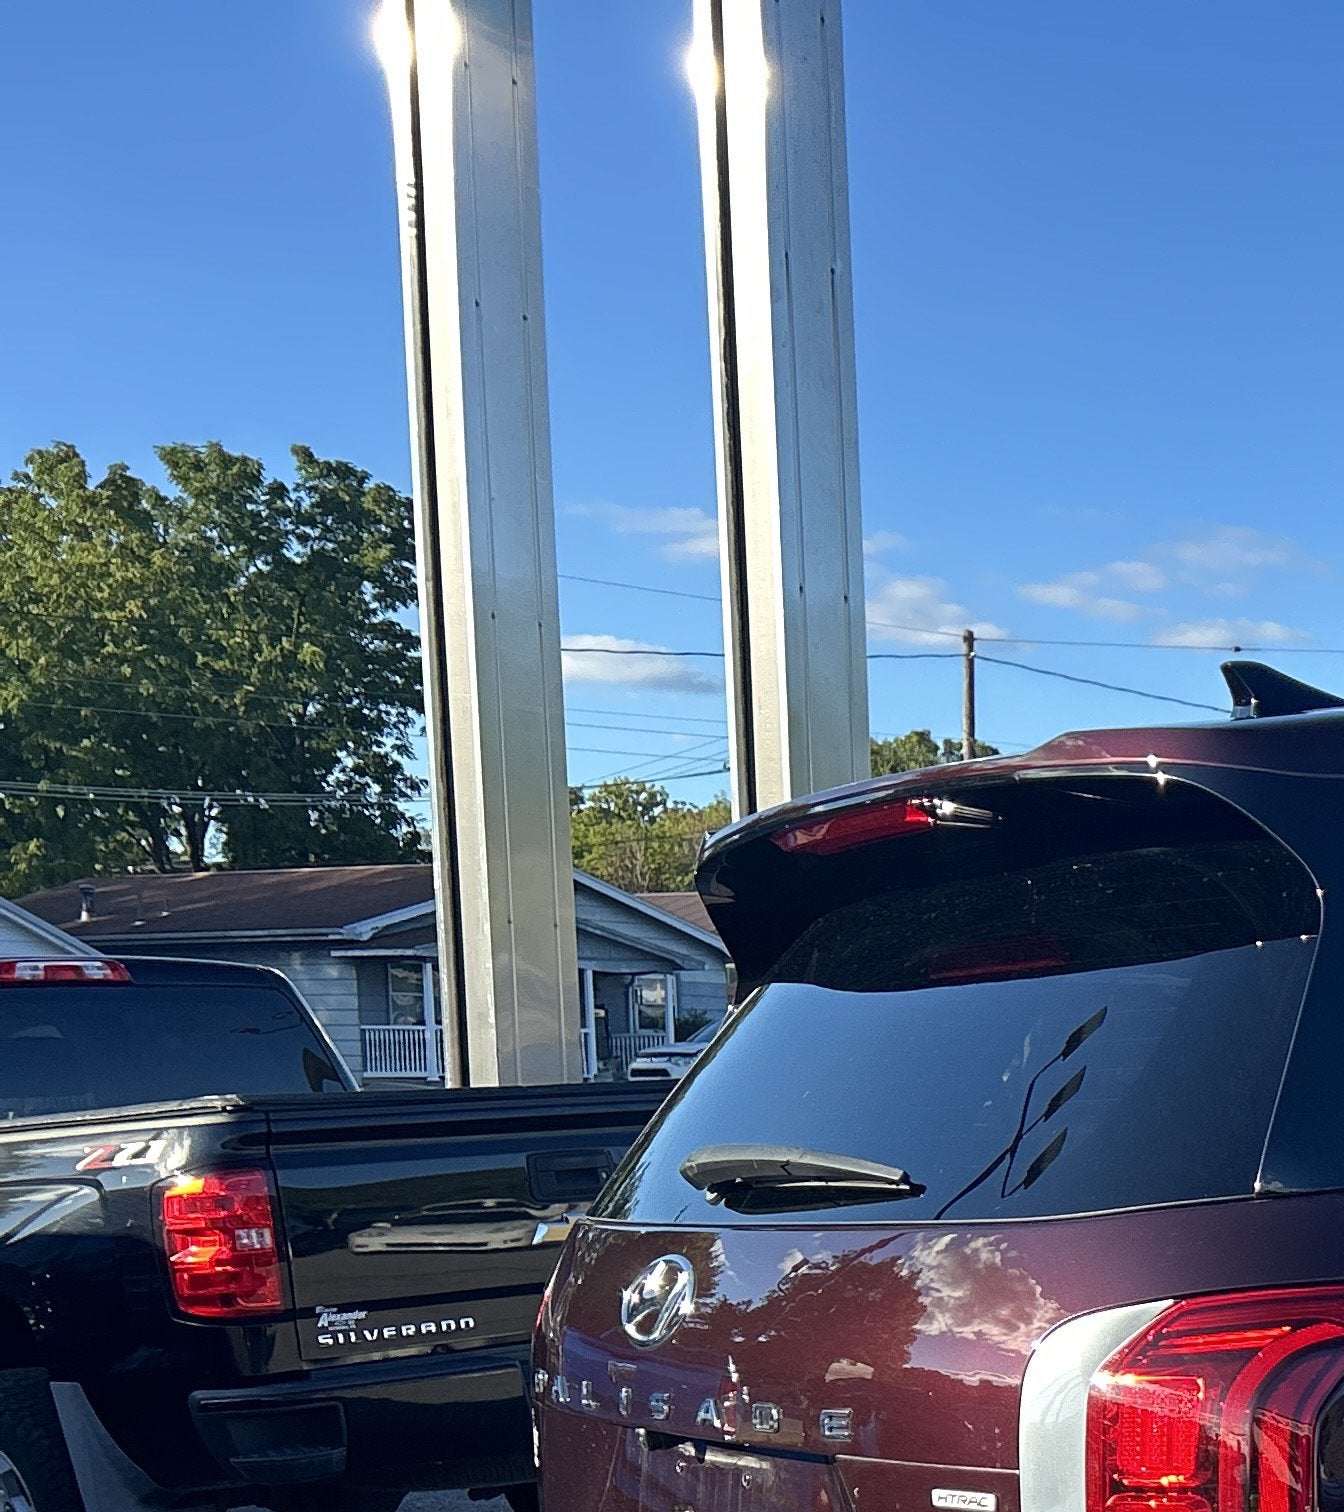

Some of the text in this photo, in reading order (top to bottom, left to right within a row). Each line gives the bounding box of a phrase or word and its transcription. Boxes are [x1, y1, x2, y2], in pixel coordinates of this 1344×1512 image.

[317, 1317, 475, 1346] SILVERADO
[534, 1367, 854, 1442] PALISADE
[937, 1493, 989, 1508] HTRAC
